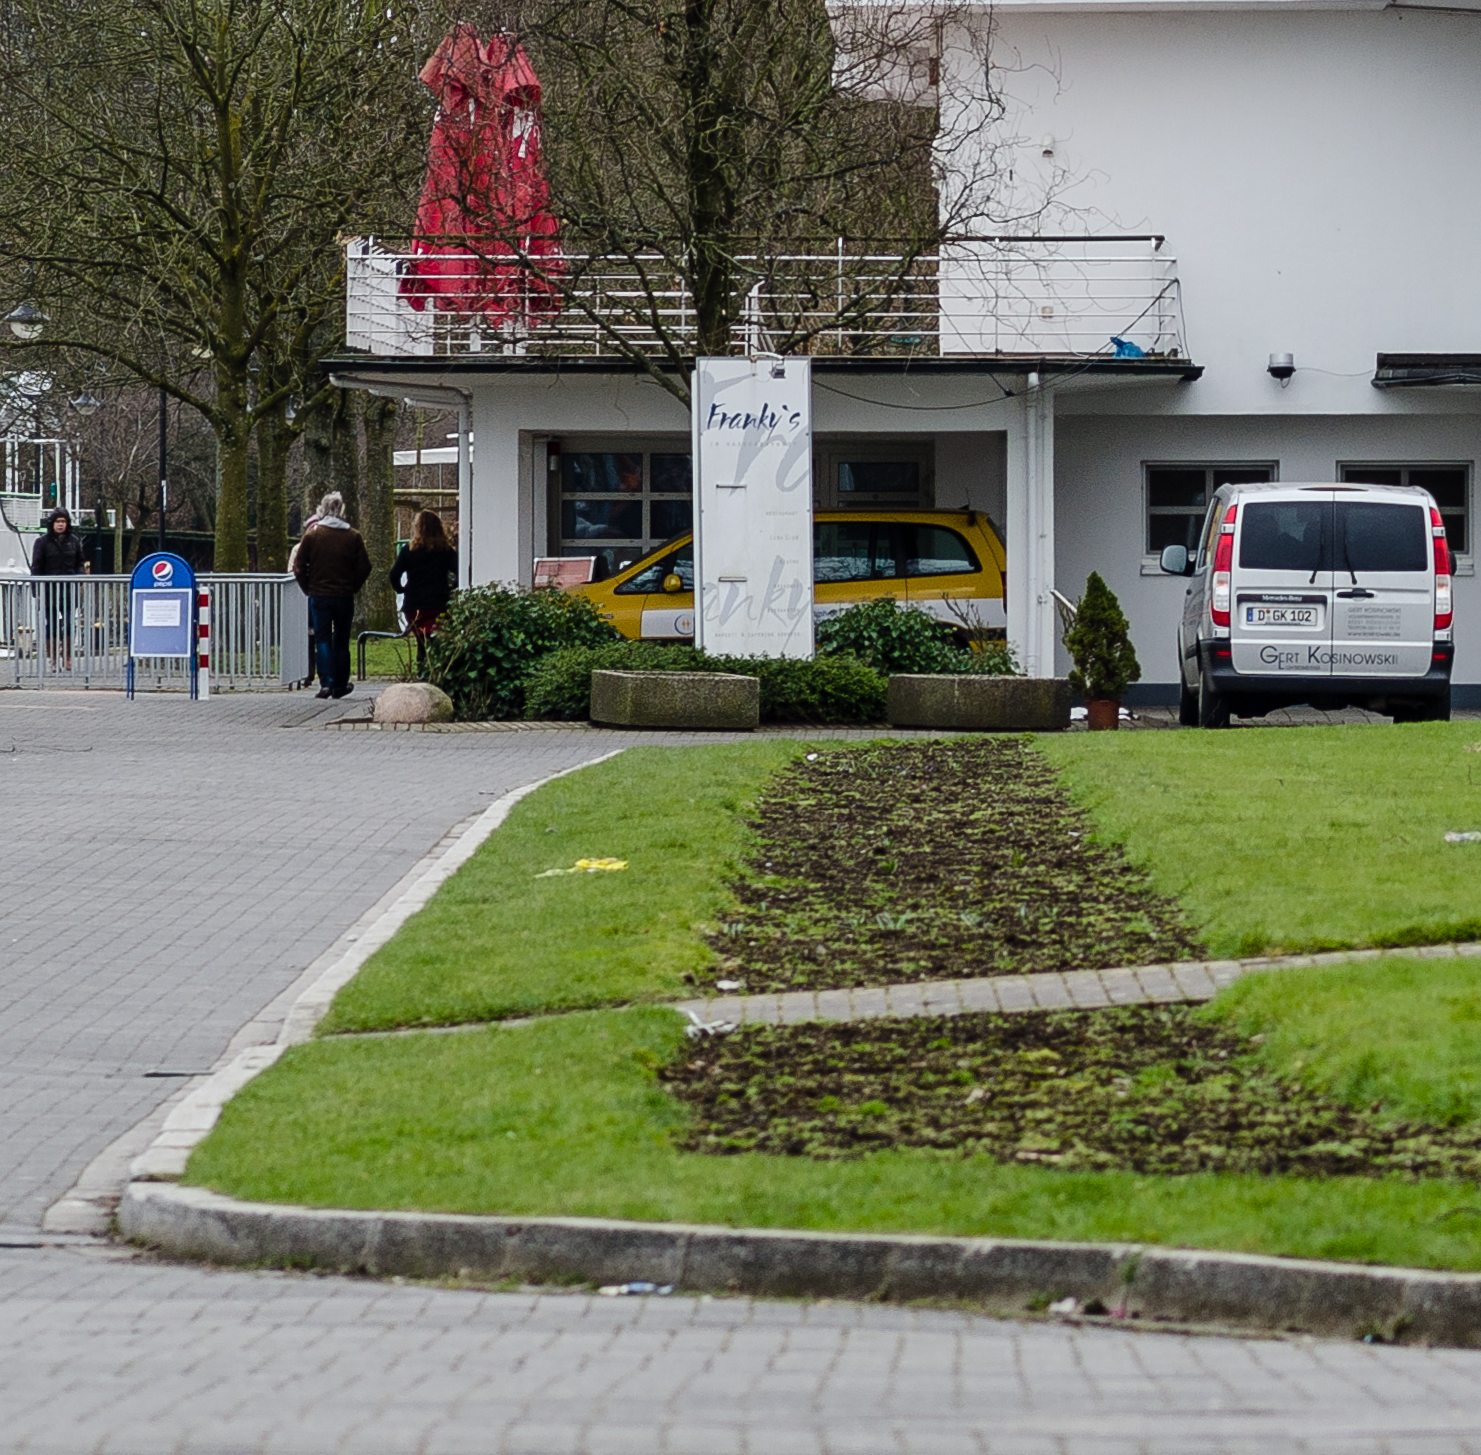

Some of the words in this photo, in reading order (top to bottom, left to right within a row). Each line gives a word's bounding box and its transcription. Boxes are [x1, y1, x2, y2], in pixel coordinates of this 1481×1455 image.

[1261, 594, 1303, 602] Mercedes-Benz
[1257, 609, 1265, 621] D
[1272, 609, 1288, 622] GK
[1291, 609, 1312, 622] 102
